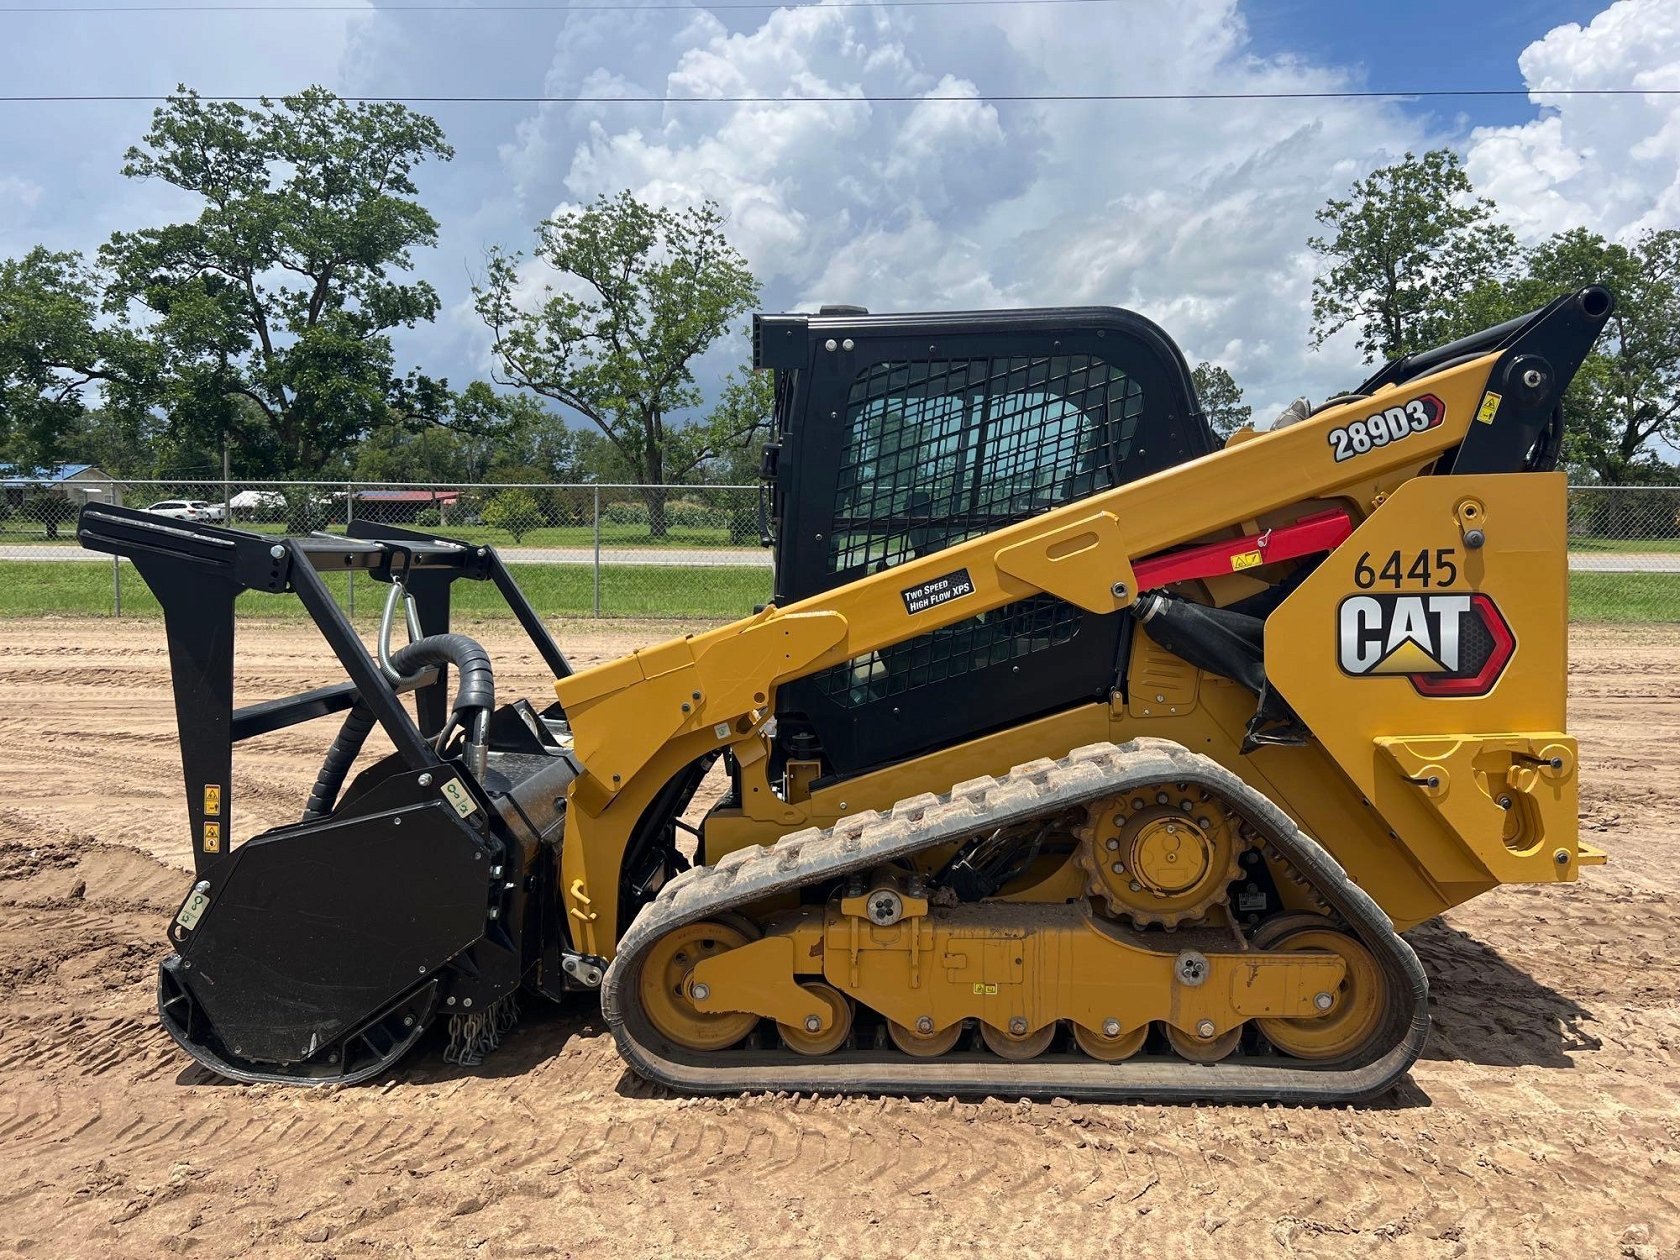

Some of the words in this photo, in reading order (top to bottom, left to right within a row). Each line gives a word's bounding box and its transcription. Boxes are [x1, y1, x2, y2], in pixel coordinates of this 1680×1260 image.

[1329, 400, 1429, 462] 289D3
[1354, 549, 1457, 589] 6445
[905, 589, 923, 602] TWO
[924, 580, 948, 595] SPEED
[910, 599, 929, 612] HIGH
[930, 590, 951, 604] FLOW
[952, 582, 970, 596] XPS
[1340, 595, 1471, 674] CAT
